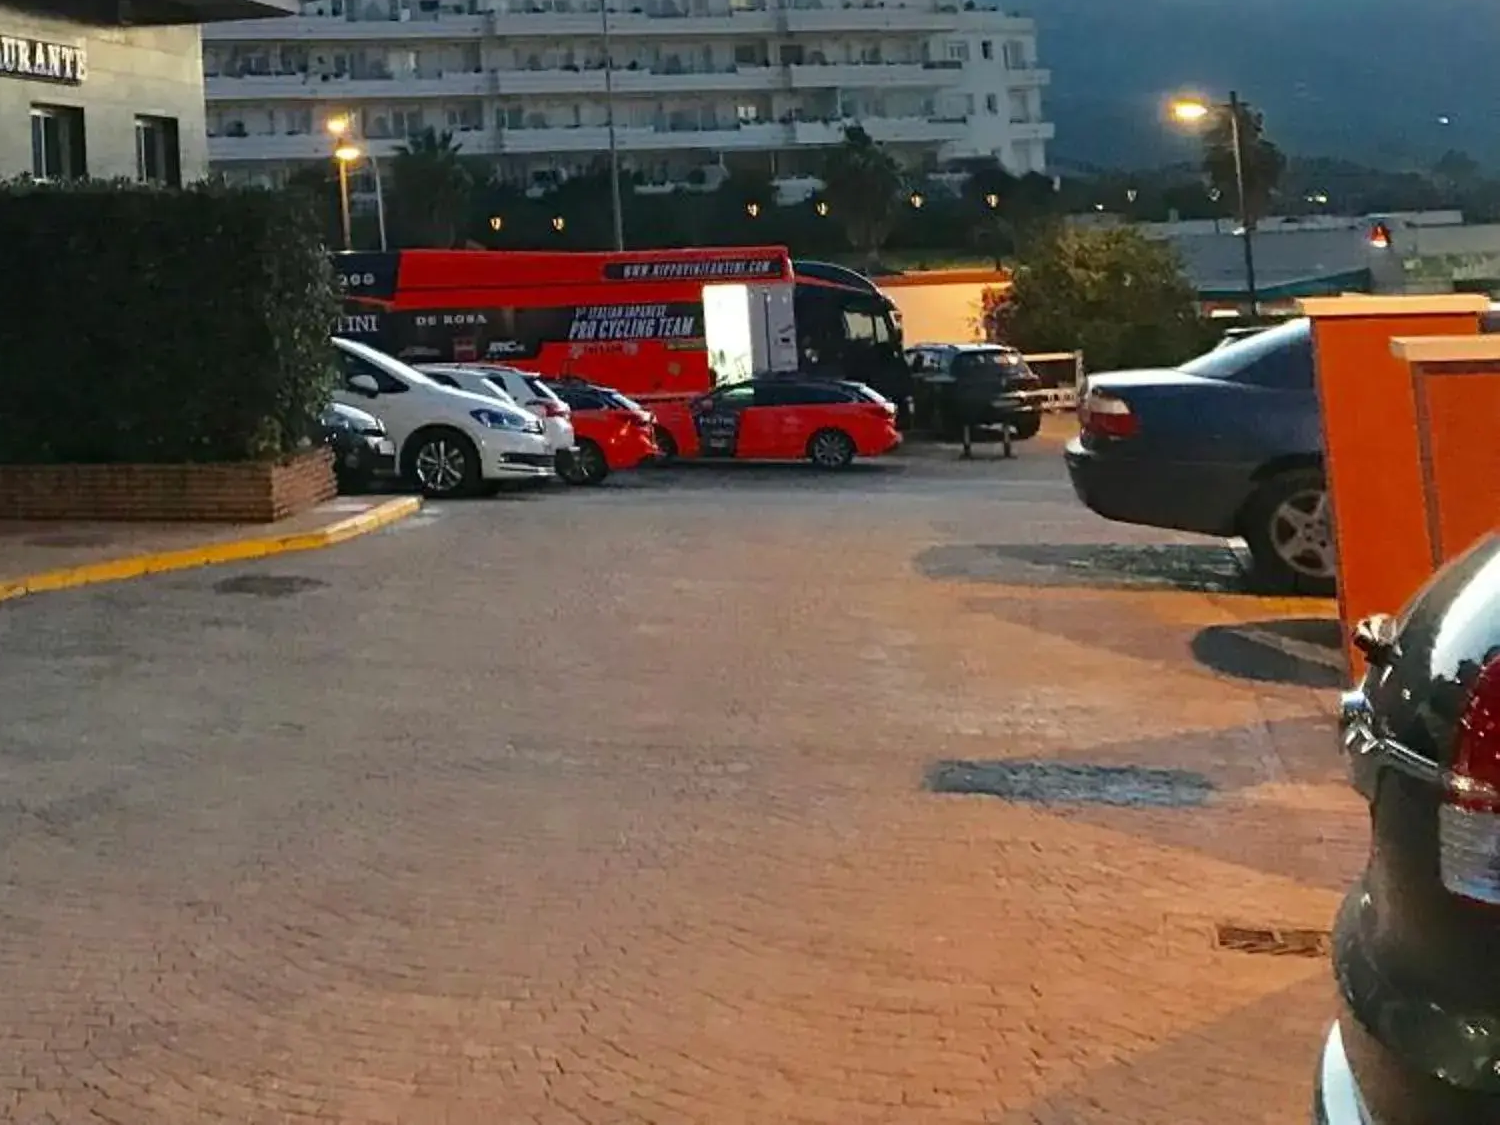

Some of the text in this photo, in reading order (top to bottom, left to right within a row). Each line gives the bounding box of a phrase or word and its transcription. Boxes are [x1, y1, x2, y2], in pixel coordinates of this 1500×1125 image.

[569, 316, 695, 339] PRO CYCLING TEAM
